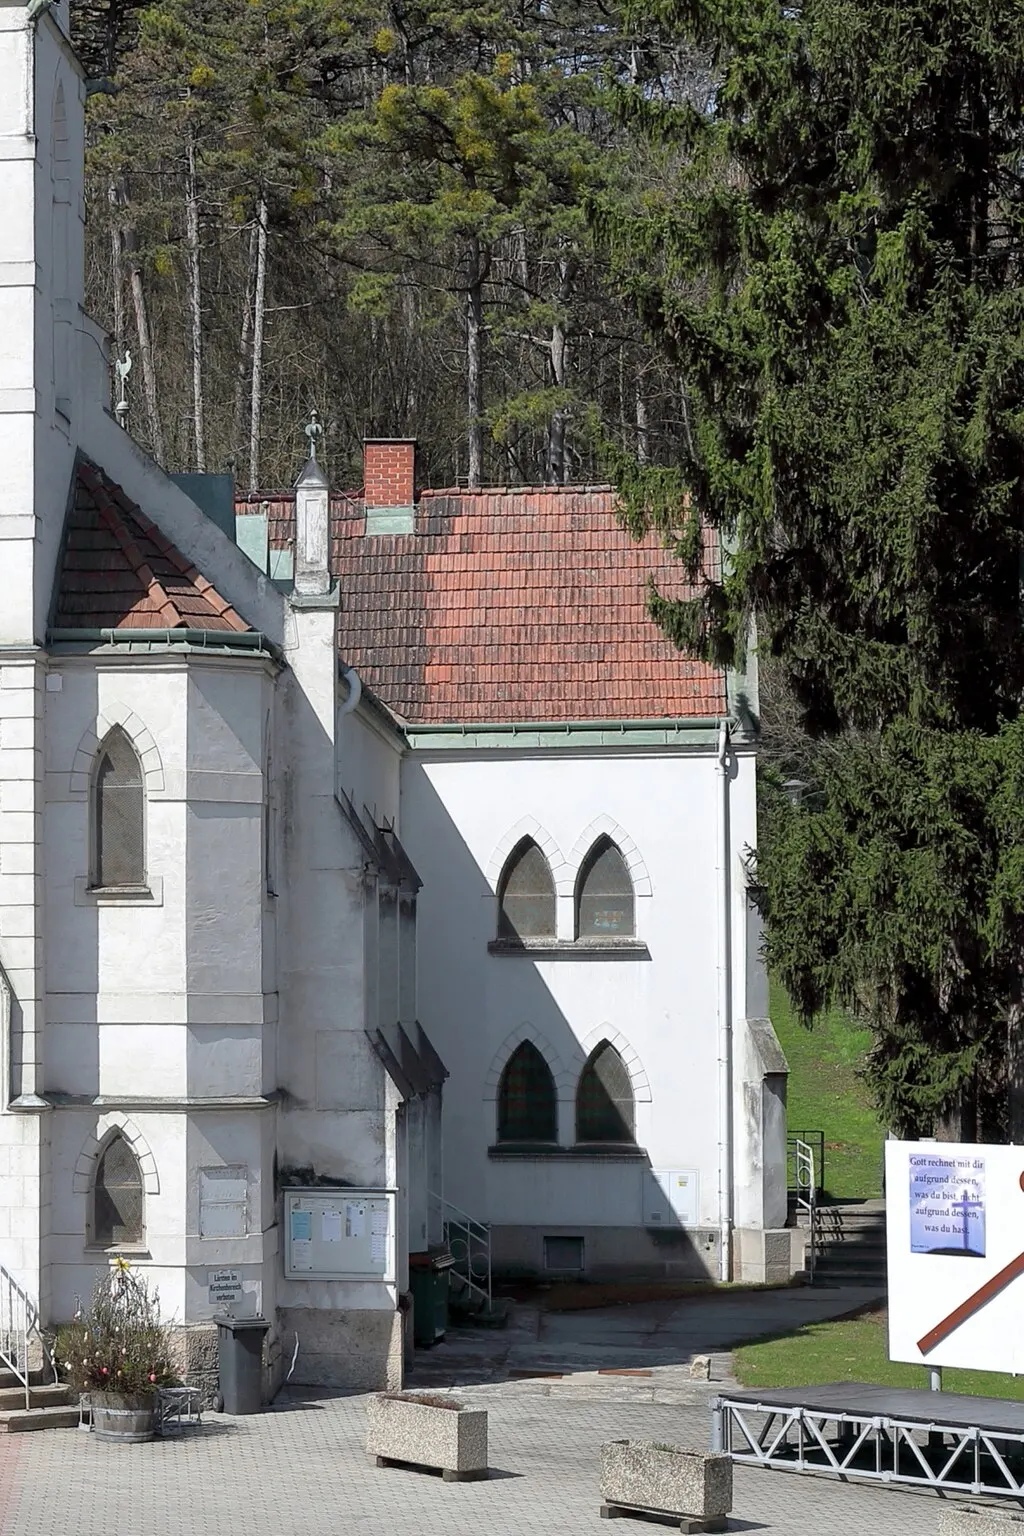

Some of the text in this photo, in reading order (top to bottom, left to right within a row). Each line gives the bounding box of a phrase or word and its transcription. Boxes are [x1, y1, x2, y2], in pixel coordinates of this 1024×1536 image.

[910, 1157, 984, 1169] Gott rechnet mit dir
[914, 1174, 979, 1186] aufgrund dessen,
[930, 1191, 941, 1200] du
[942, 1191, 959, 1202] bist,
[960, 1193, 979, 1202] nicht
[915, 1207, 979, 1219] aufgrund dessen,
[924, 1224, 970, 1235] was du hast.
